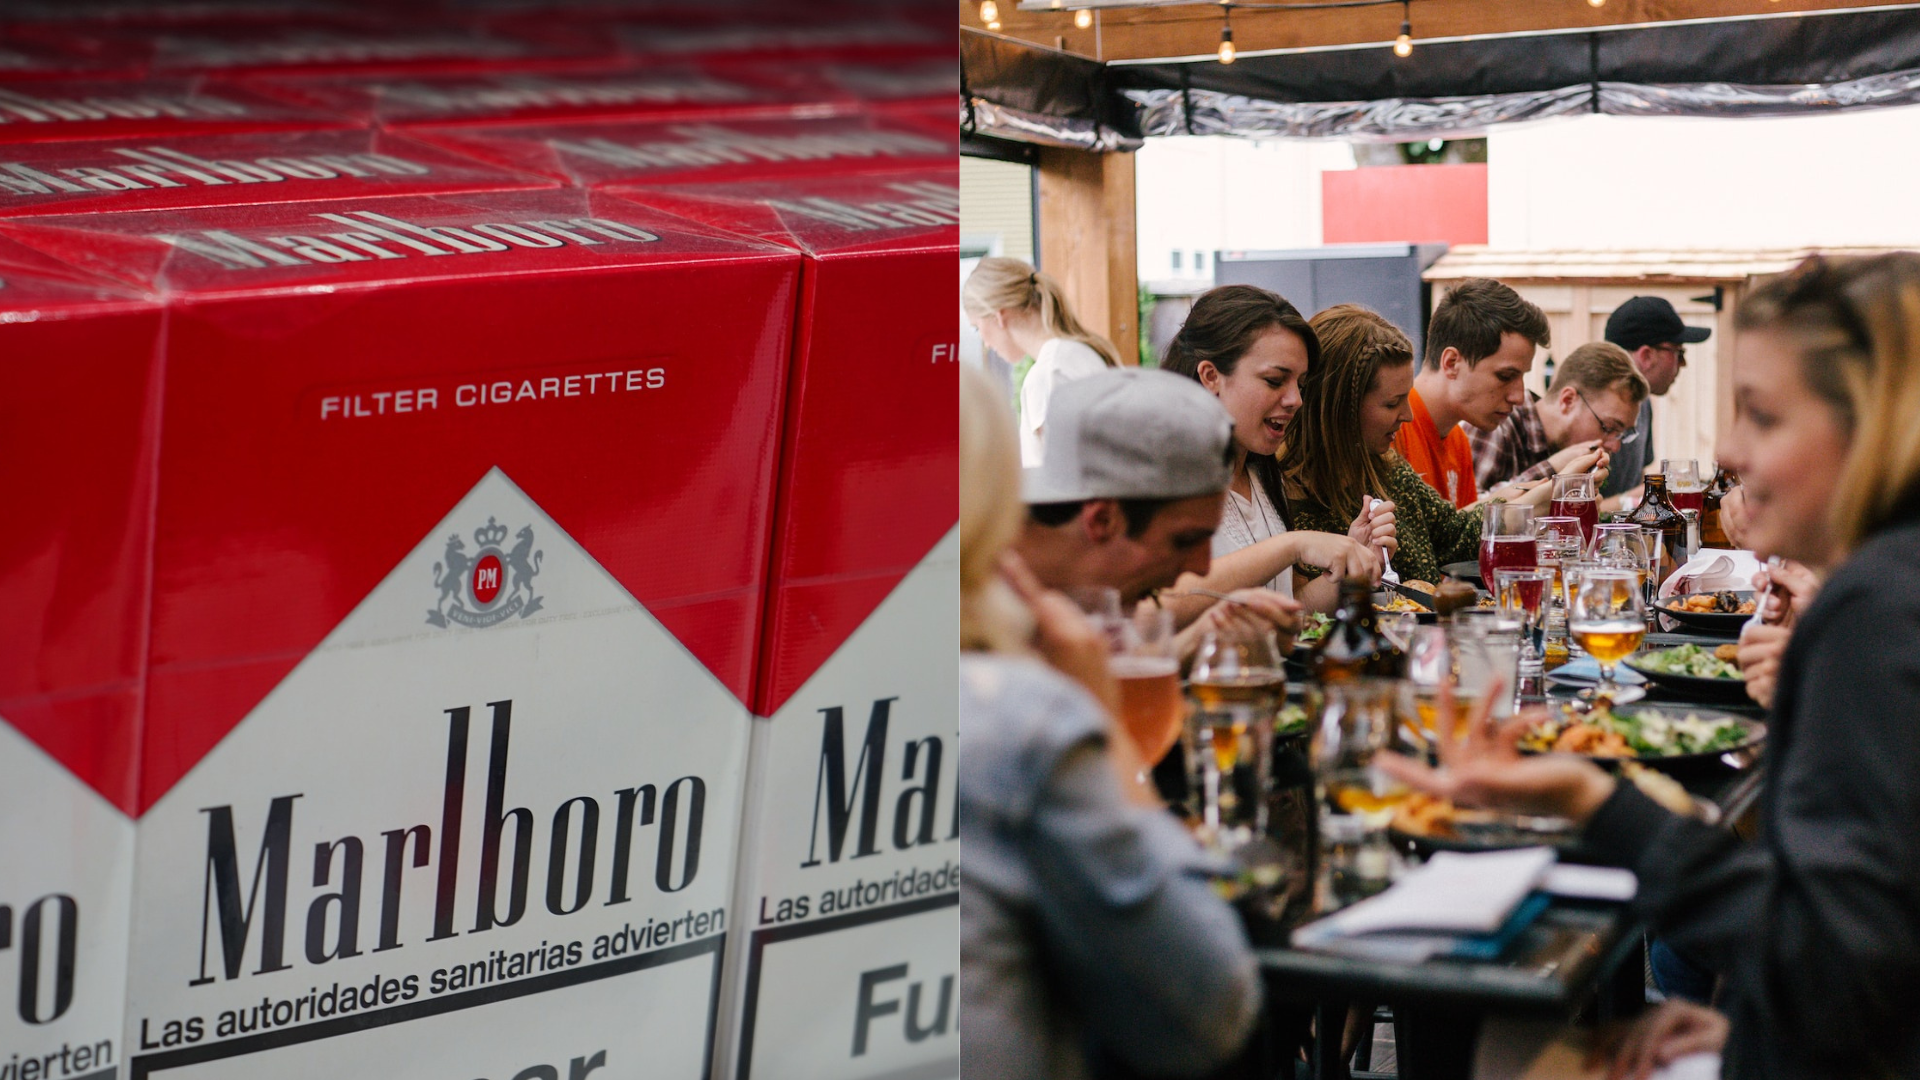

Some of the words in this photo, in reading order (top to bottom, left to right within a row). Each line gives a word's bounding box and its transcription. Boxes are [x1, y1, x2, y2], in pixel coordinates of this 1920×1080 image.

[0, 147, 430, 195] Marlboro
[150, 210, 660, 269] Marlboro
[320, 388, 438, 420] FILTER
[455, 367, 666, 407] CIGARETTES
[477, 567, 498, 590] PM
[188, 699, 706, 987] Marlboro
[759, 896, 809, 925] Las
[140, 1017, 204, 1051] Las
[217, 974, 419, 1037] autoridades
[429, 937, 582, 995] sanitarias
[592, 907, 725, 961] advierten
